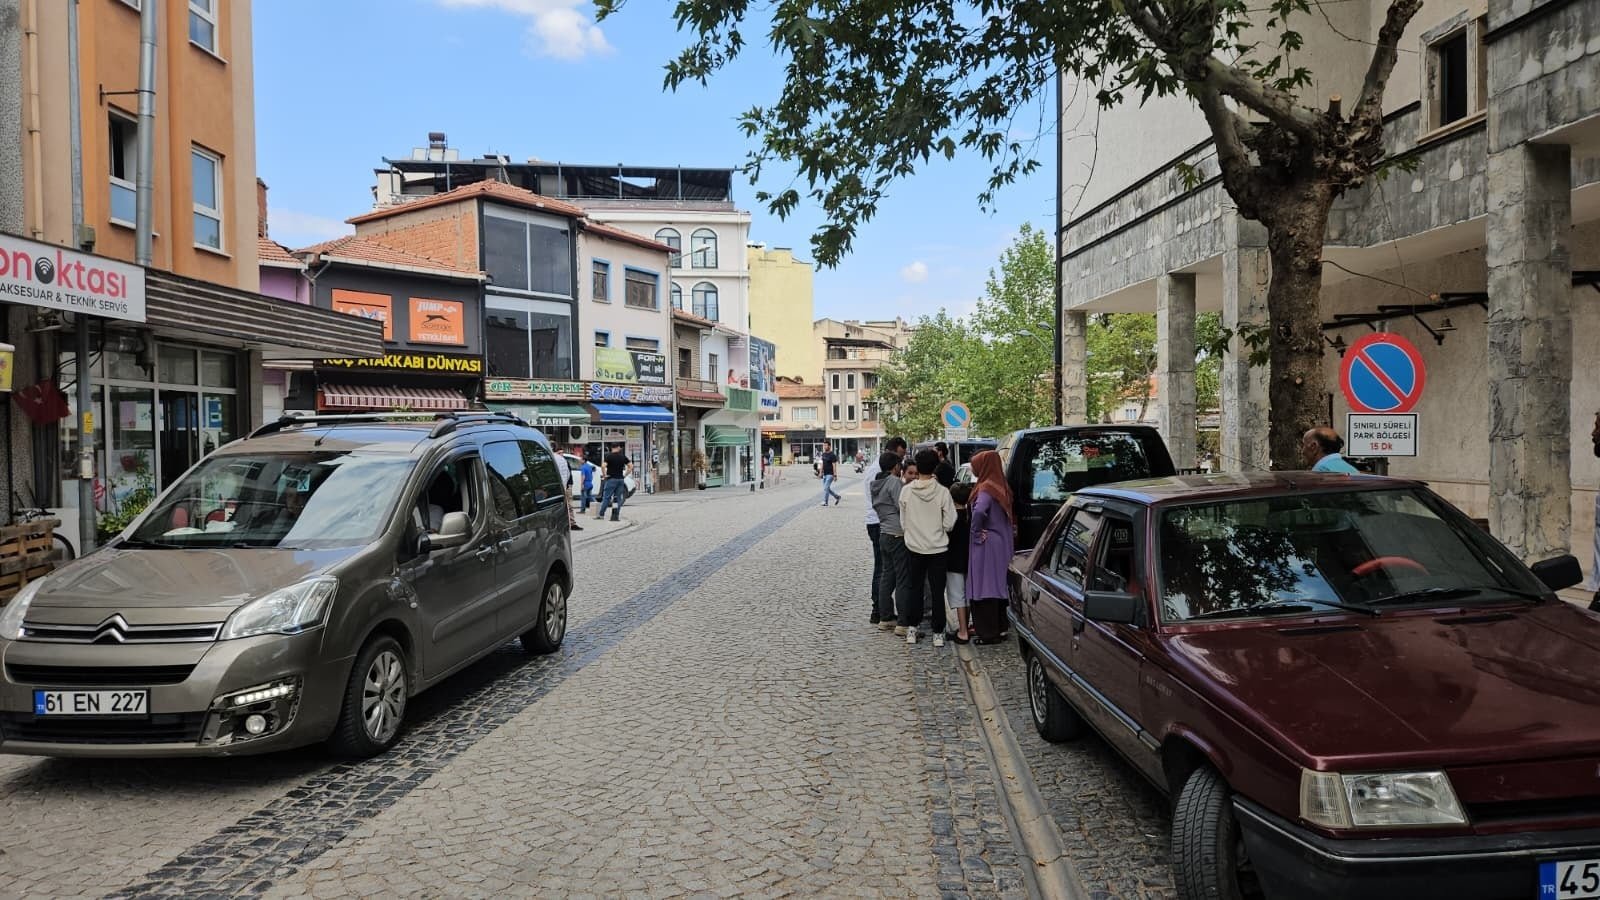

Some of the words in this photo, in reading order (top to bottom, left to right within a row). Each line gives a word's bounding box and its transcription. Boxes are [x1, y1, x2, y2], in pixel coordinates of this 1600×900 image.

[0, 283, 53, 301] AKSESUAR
[55, 292, 62, 303] &
[65, 294, 97, 309] TEKNİK
[99, 300, 128, 314] SERVİS
[427, 355, 480, 371] DÜNYASI
[1383, 421, 1411, 429] SÜRELİ
[1377, 431, 1410, 439] BÖLGESİ
[1370, 442, 1378, 450] 15
[1381, 442, 1392, 450] Dk
[45, 693, 63, 712] 61
[74, 693, 100, 712] EN
[111, 693, 145, 712] 227
[1541, 884, 1555, 894] TR
[1560, 863, 1600, 895] 45
